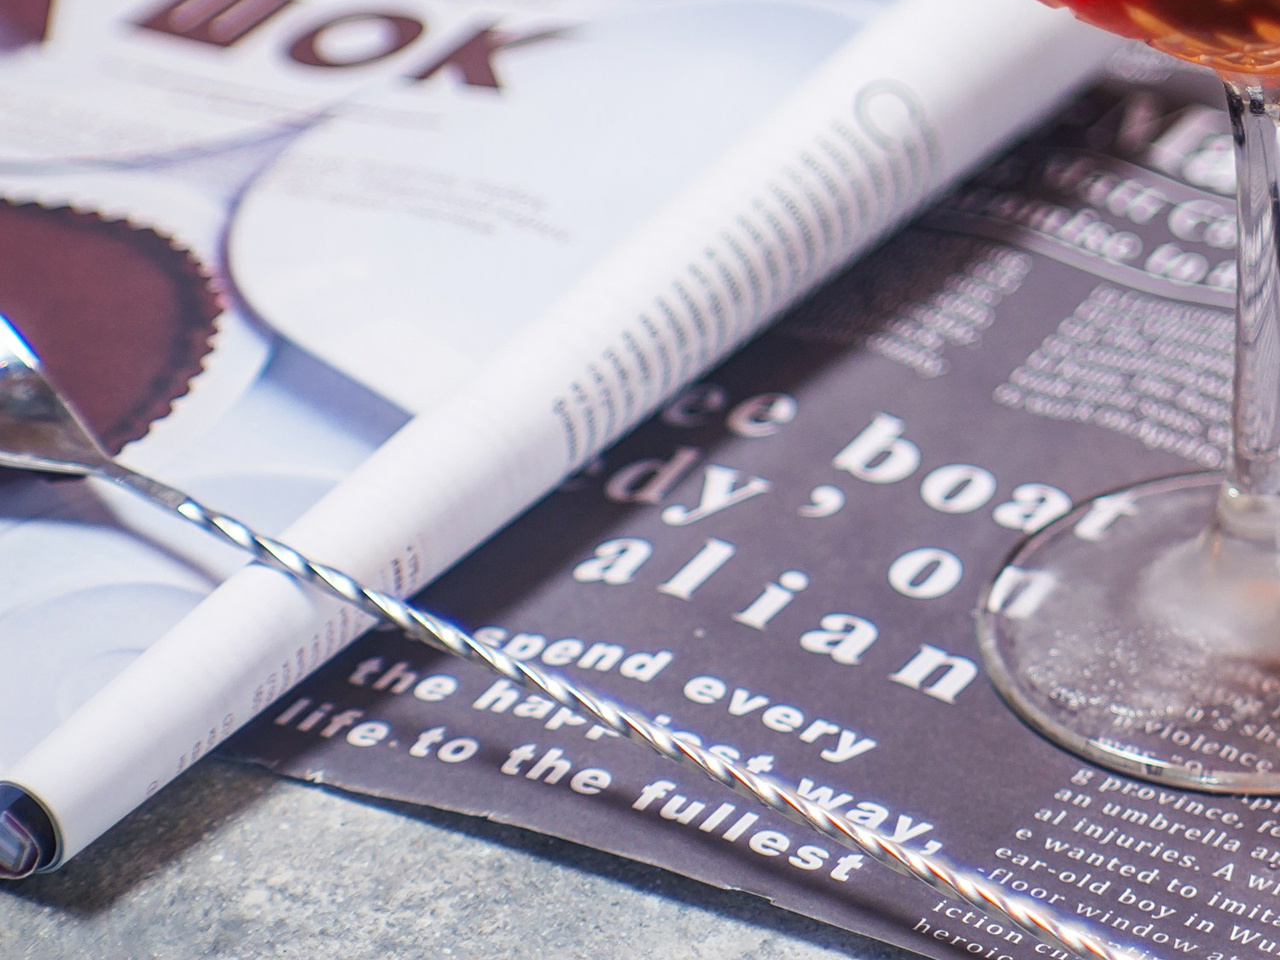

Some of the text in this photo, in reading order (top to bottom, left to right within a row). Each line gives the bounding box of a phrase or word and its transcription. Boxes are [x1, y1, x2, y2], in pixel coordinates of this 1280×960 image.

[573, 537, 978, 705] alian
[348, 656, 459, 702] the
[683, 676, 878, 765] every
[409, 726, 481, 764] to
[500, 744, 613, 795] the
[631, 780, 865, 883] fullest
[1053, 787, 1093, 809] an
[1101, 801, 1242, 853] umbrella
[1098, 776, 1245, 830] province,
[1014, 826, 1033, 842] e
[1043, 837, 1161, 886] wanted
[1165, 878, 1199, 900] to
[1033, 807, 1068, 827] al
[1071, 817, 1200, 872] injuries.
[1211, 862, 1236, 882] A
[994, 846, 1112, 897] ear-old
[1117, 887, 1178, 921] boy
[1182, 912, 1217, 935] in
[1075, 902, 1200, 954] window
